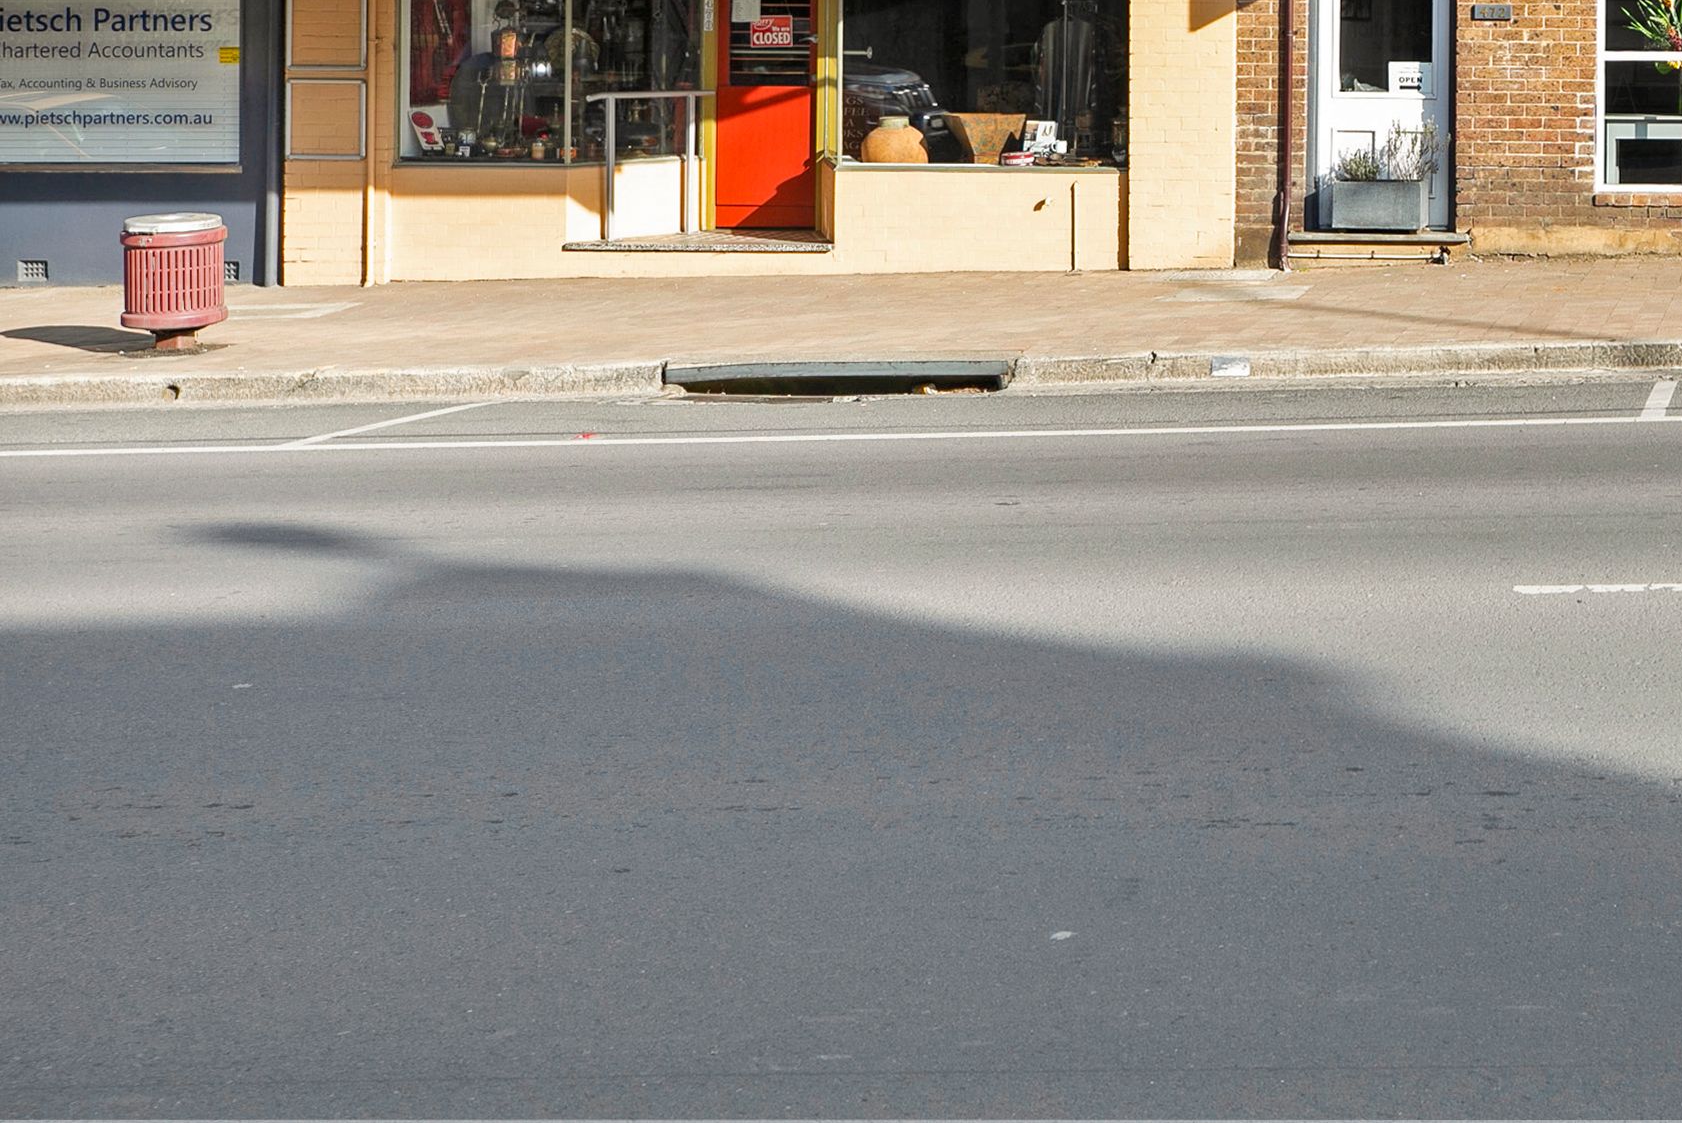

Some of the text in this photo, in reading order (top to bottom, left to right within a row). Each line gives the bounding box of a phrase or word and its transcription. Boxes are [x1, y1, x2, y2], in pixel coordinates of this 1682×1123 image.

[1478, 7, 1506, 19] 472
[94, 8, 213, 32] Partners
[753, 32, 791, 45] CLOSED
[0, 41, 82, 58] hartered
[88, 41, 205, 59] Accountants
[0, 78, 199, 91] ax, Accounting & Business Advisory
[1398, 76, 1424, 84] OPEN
